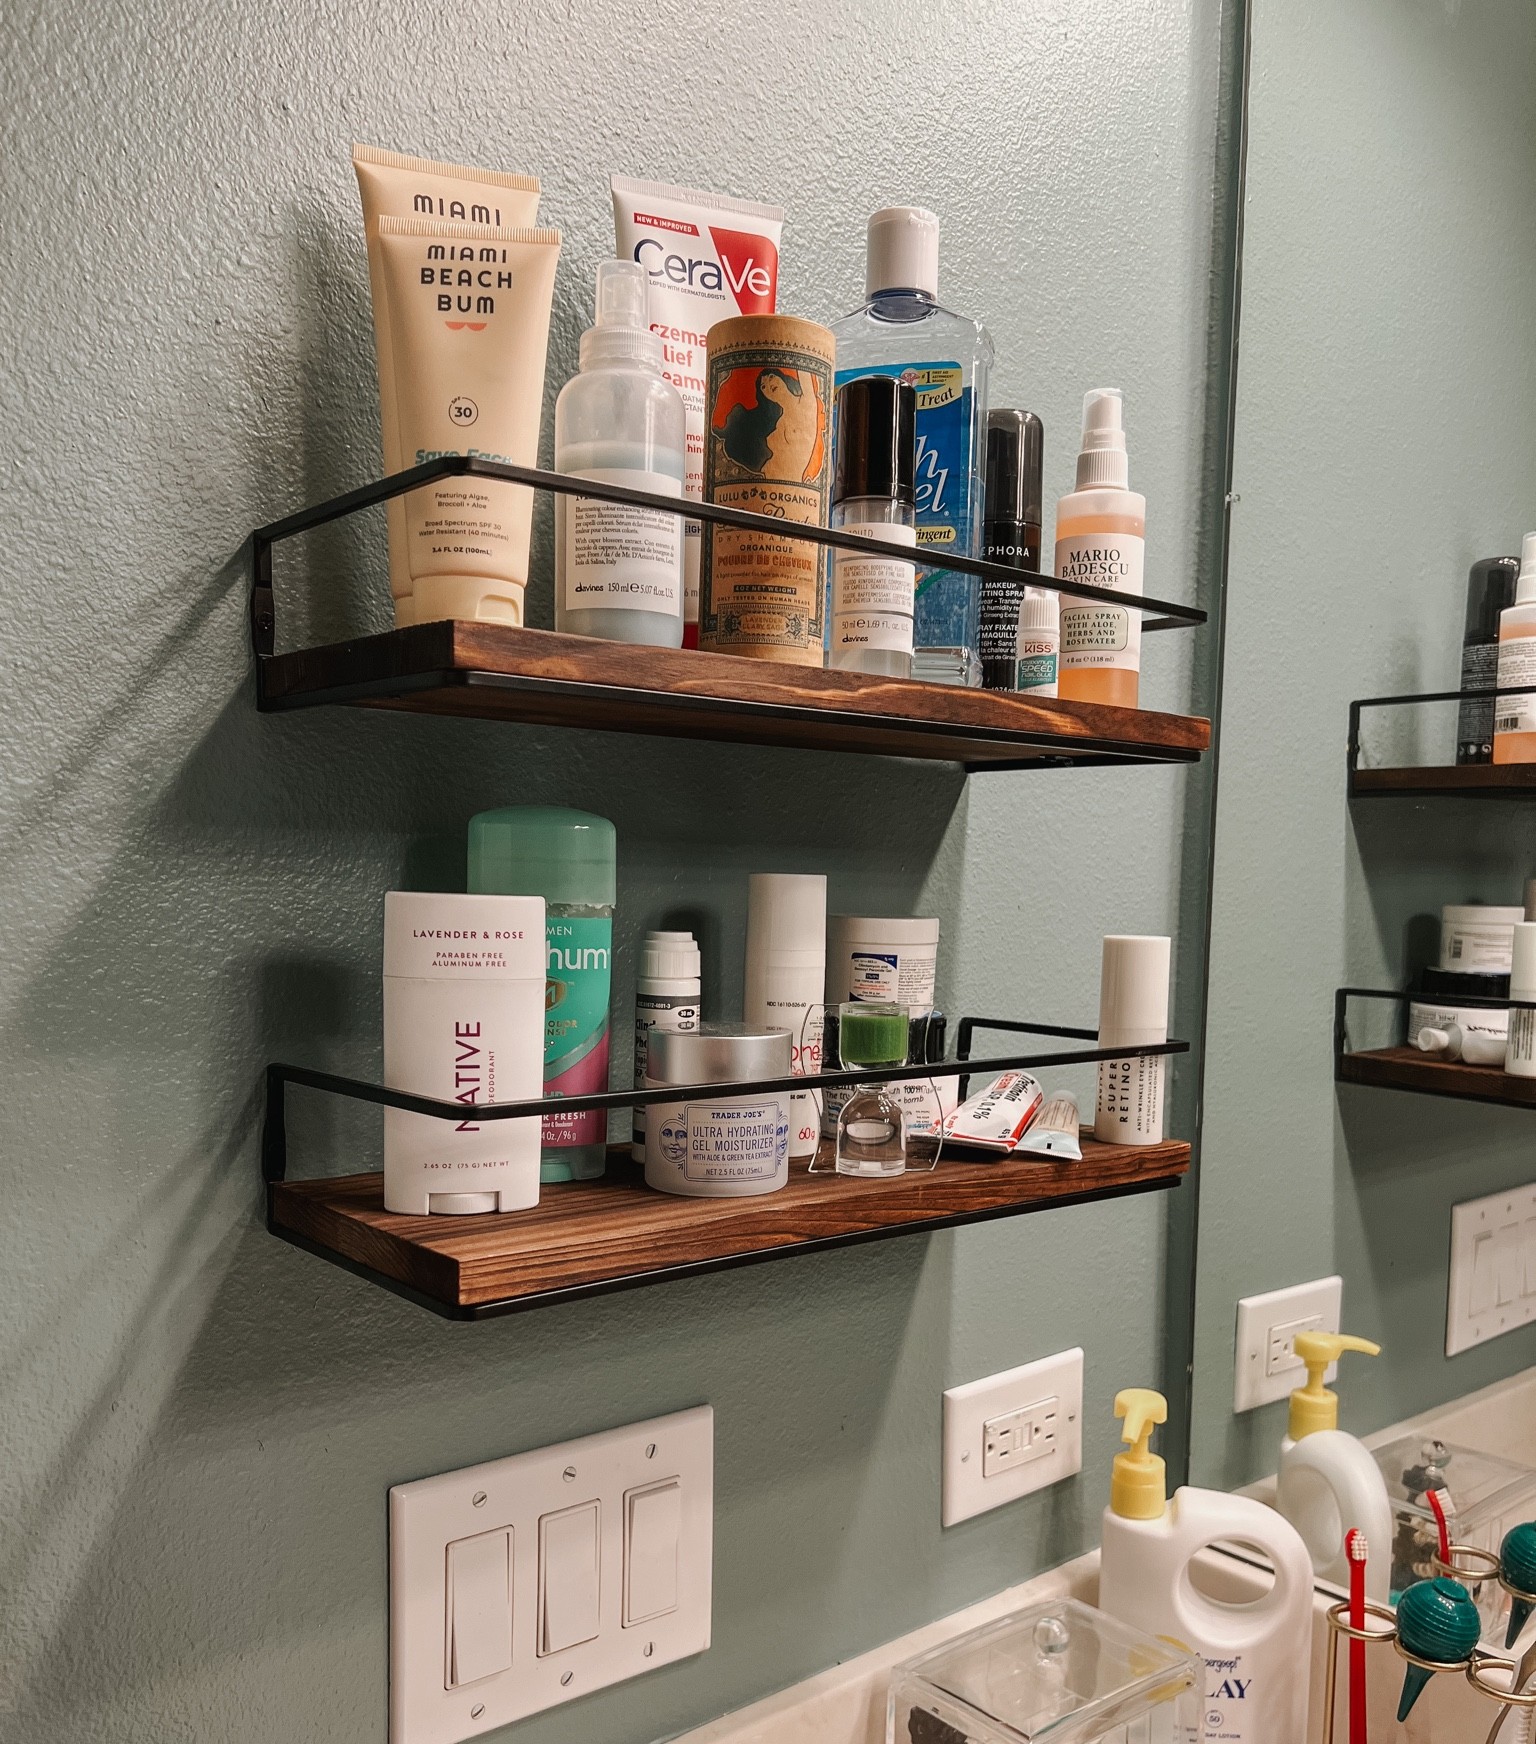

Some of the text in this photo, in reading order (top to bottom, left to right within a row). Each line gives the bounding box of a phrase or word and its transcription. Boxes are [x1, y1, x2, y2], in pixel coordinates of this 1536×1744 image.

[413, 194, 501, 225] MIAMI
[637, 215, 651, 224] NEW
[660, 220, 692, 233] IMPROVED
[427, 245, 507, 263] MIAMI
[634, 239, 771, 296] CeraVe
[420, 268, 513, 289] BEACH
[667, 284, 680, 293] WITH
[681, 287, 726, 301] DERMATOLOGISTS
[437, 294, 495, 314] BUM
[919, 387, 954, 407] Treat
[454, 407, 472, 418] 30
[469, 493, 490, 501] Algae,
[719, 492, 817, 507] LULU ORGANICS
[481, 530, 509, 541] minutes)
[740, 544, 793, 553] ORGANIQUE
[1070, 549, 1120, 564] MARIO
[718, 555, 754, 566] POUDRE
[772, 557, 812, 571] CHEVEUX
[1062, 562, 1129, 578] BADESCU
[575, 582, 604, 593] davines
[608, 583, 620, 592] 150
[640, 585, 653, 594] 5.07
[768, 586, 796, 594] WEIGHT
[1064, 614, 1091, 622] FACIAL
[867, 620, 880, 628] 1.69
[1091, 621, 1117, 629] ALOE,
[842, 633, 869, 643] davines
[1068, 630, 1093, 638] HERBS
[1066, 638, 1116, 646] ROSEWATER
[1025, 644, 1051, 653] KISS
[413, 930, 524, 939] LAVENDER & ROSE
[546, 926, 572, 936] MEN
[1108, 1063, 1117, 1112] SUPER
[1120, 1063, 1130, 1122] RETINO
[826, 1091, 837, 1099] The
[904, 1096, 924, 1104] bomb
[555, 1112, 586, 1120] FRESH
[711, 1111, 740, 1119] TRADER
[693, 1124, 774, 1138] ULTRA HYDRATING
[692, 1138, 774, 1152] GEL MOISTURIZER
[727, 1153, 744, 1161] GREEN
[755, 1150, 773, 1160] EXTRACT
